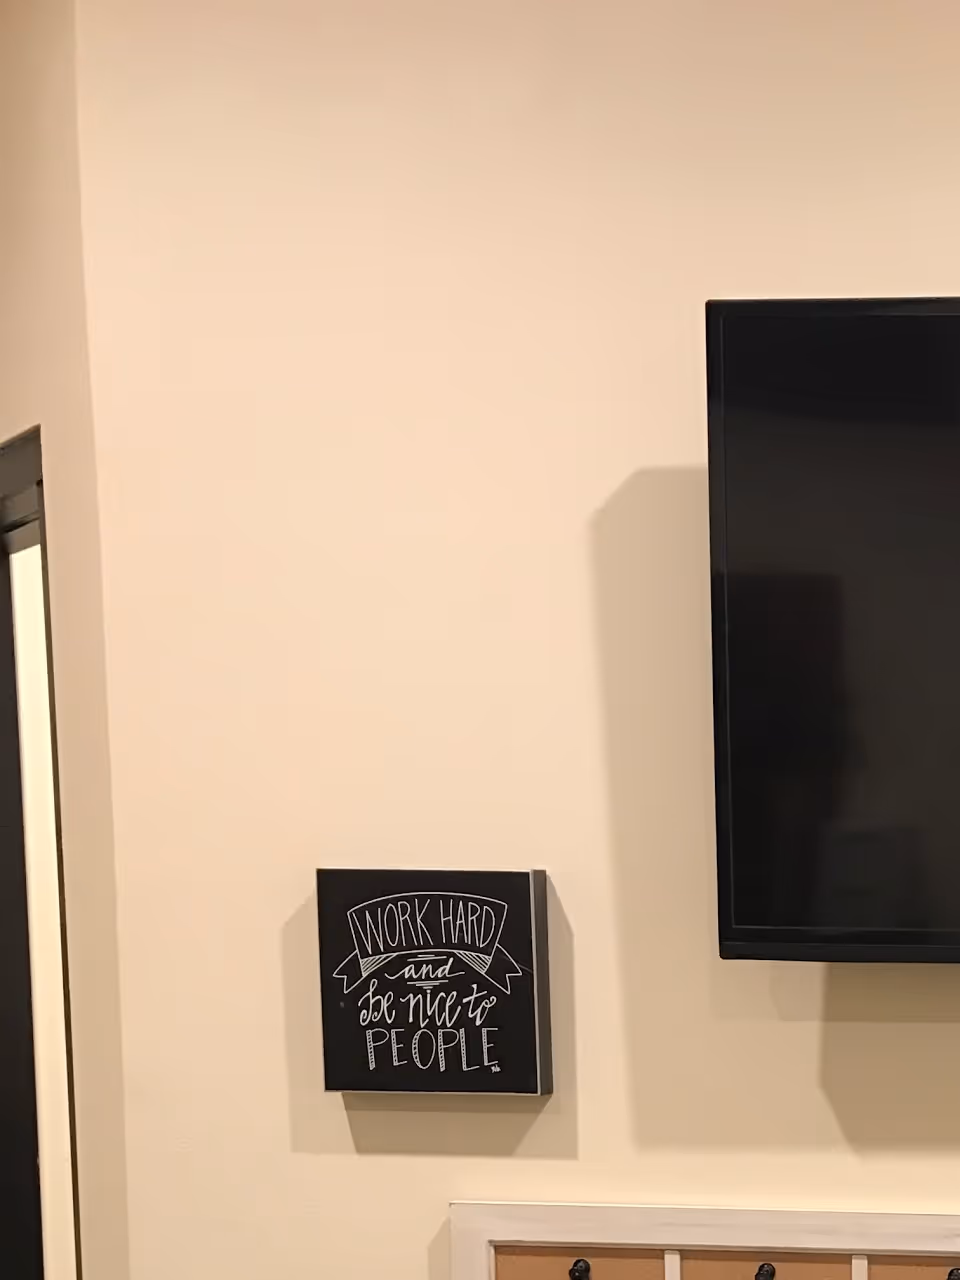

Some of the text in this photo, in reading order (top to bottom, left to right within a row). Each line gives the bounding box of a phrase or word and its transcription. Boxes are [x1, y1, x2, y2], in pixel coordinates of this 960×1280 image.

[352, 898, 496, 955] WORK HARD
[385, 957, 465, 979] and
[358, 978, 497, 1028] be nice to
[365, 1027, 499, 1072] PEOPLE
